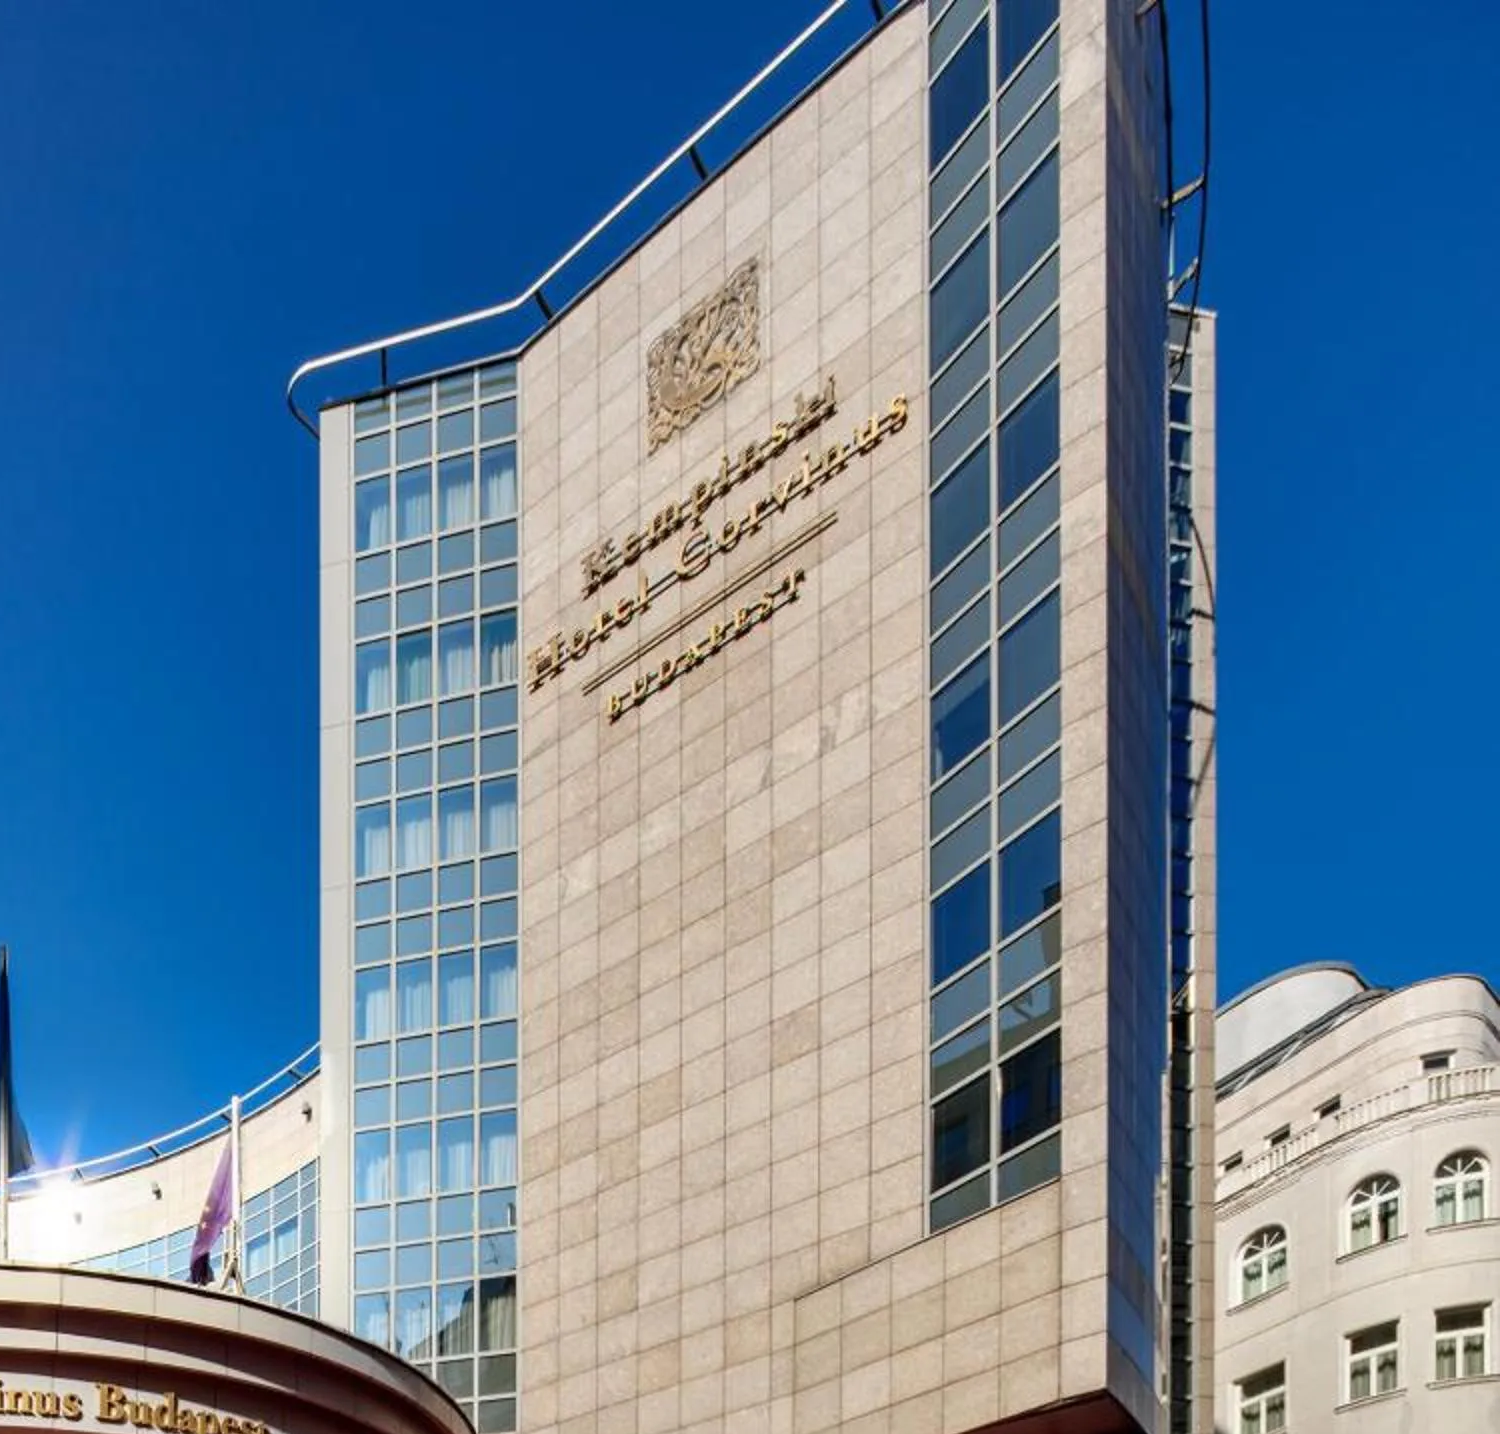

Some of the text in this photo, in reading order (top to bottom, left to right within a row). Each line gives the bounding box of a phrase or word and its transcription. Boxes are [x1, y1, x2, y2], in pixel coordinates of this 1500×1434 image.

[525, 392, 909, 695] Hotel Corvinus
[581, 373, 839, 600] Kempinski
